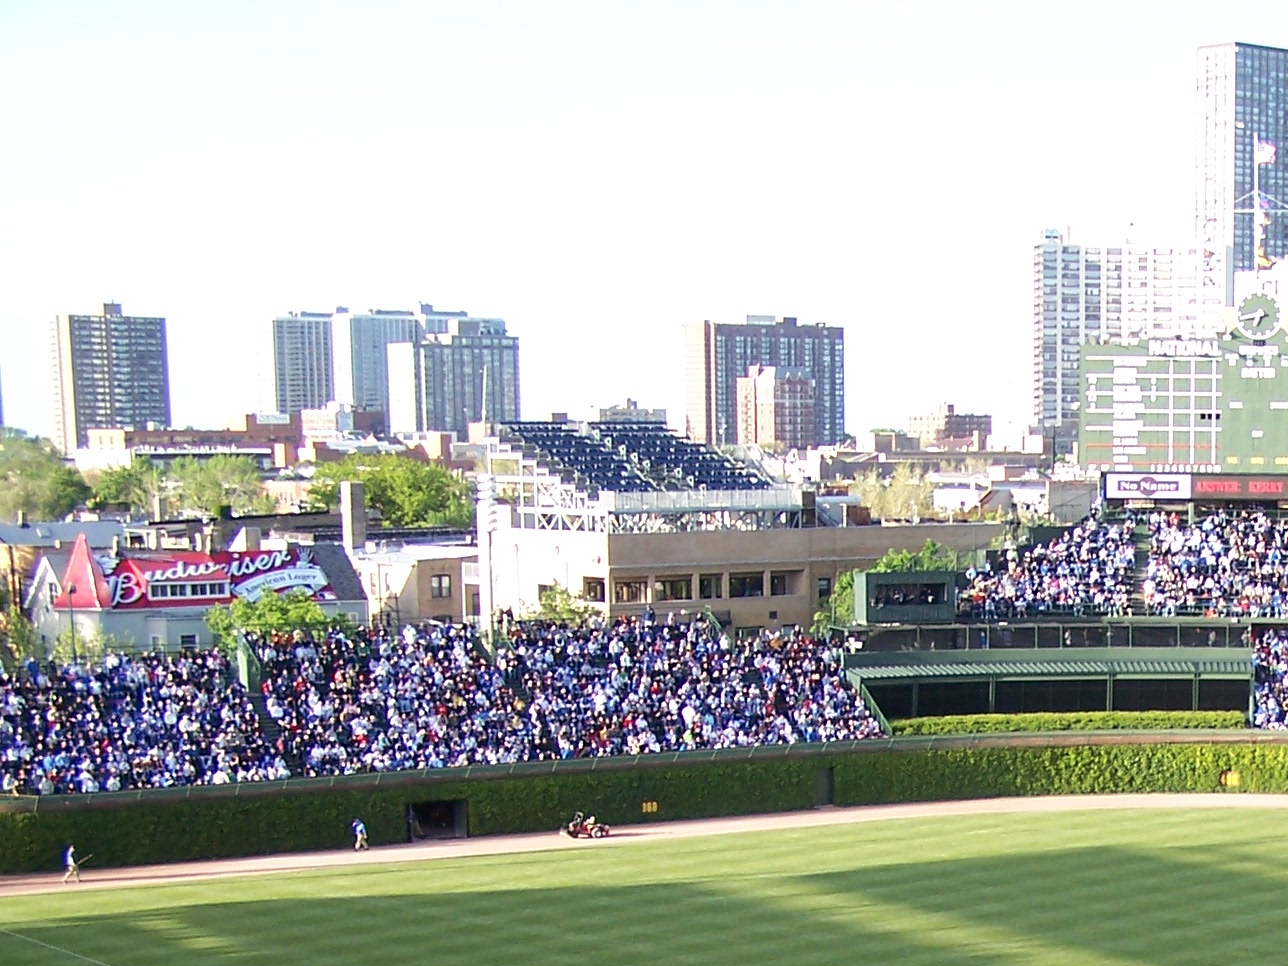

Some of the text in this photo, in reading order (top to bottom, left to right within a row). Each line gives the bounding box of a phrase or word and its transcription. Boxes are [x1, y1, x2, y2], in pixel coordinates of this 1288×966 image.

[1149, 340, 1222, 356] NATIONAL
[1120, 481, 1177, 491] No Name
[107, 550, 291, 606] Budwiser
